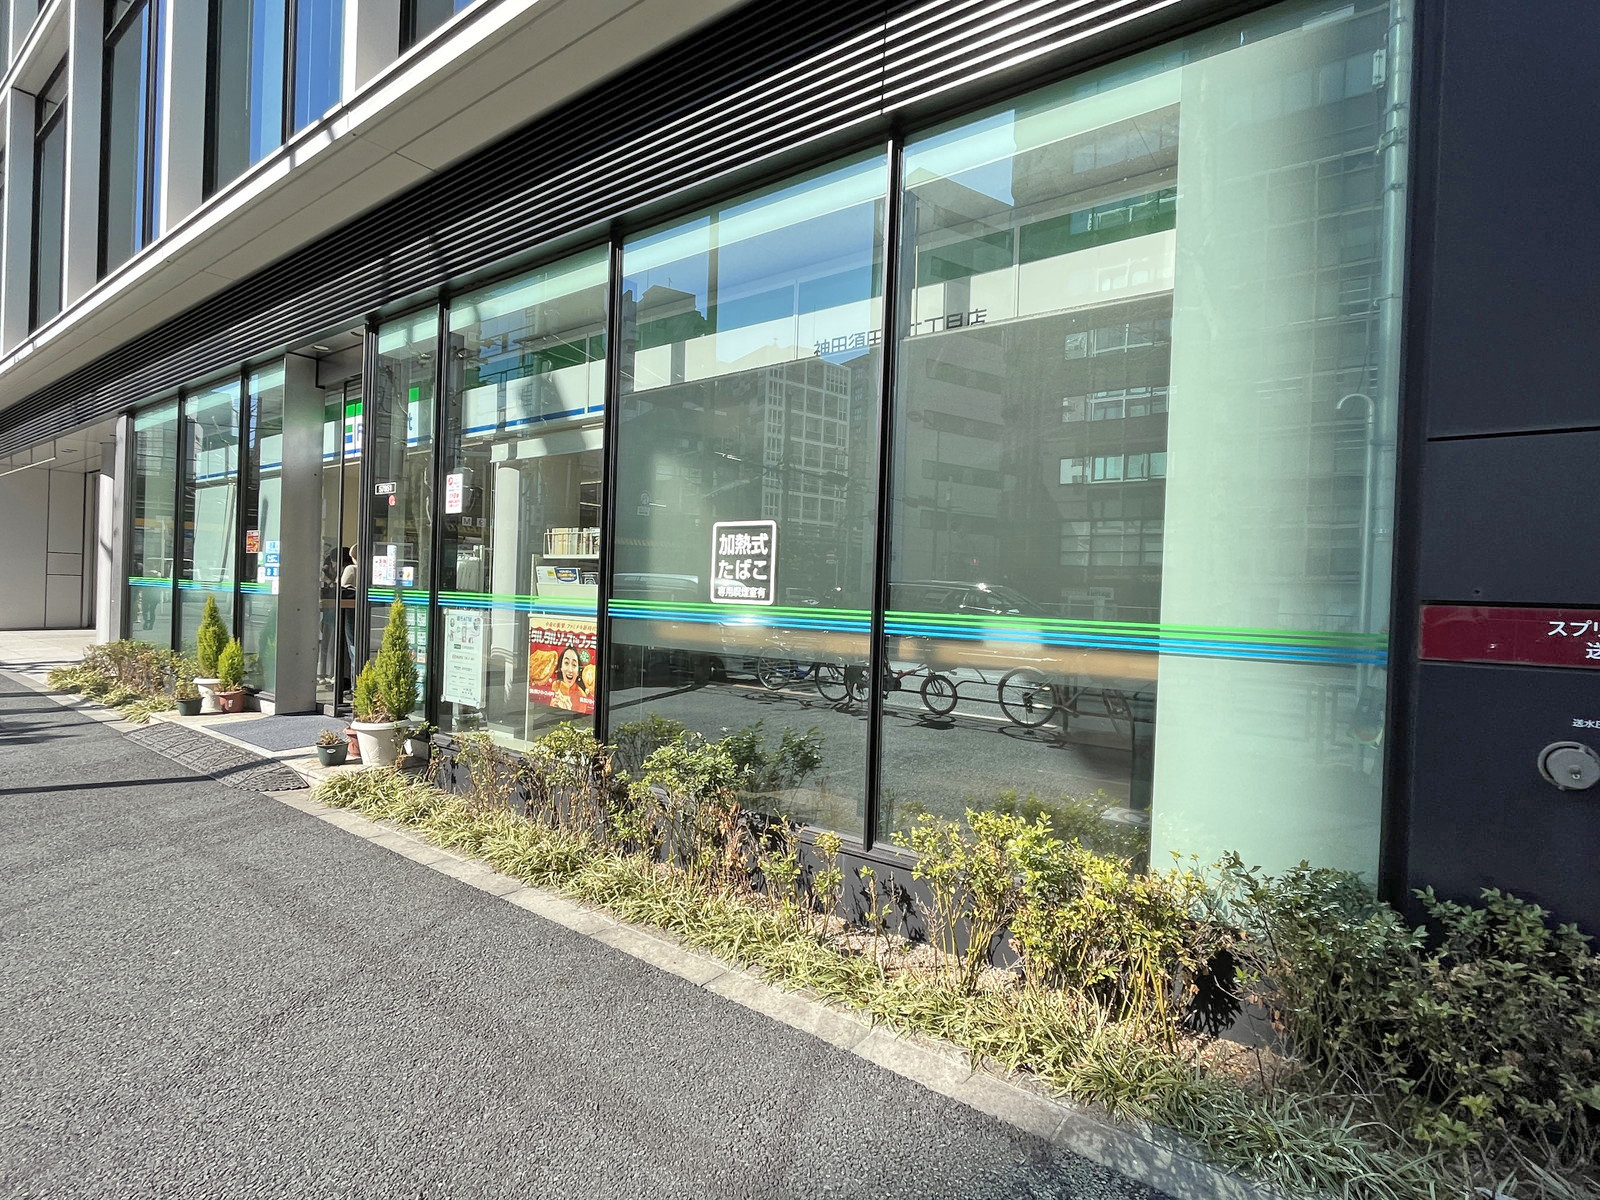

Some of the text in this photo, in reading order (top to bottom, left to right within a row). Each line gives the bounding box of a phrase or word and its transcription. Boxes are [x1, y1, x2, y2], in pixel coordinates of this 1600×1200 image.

[718, 532, 769, 556] 加熱式
[718, 558, 767, 580] たばこ
